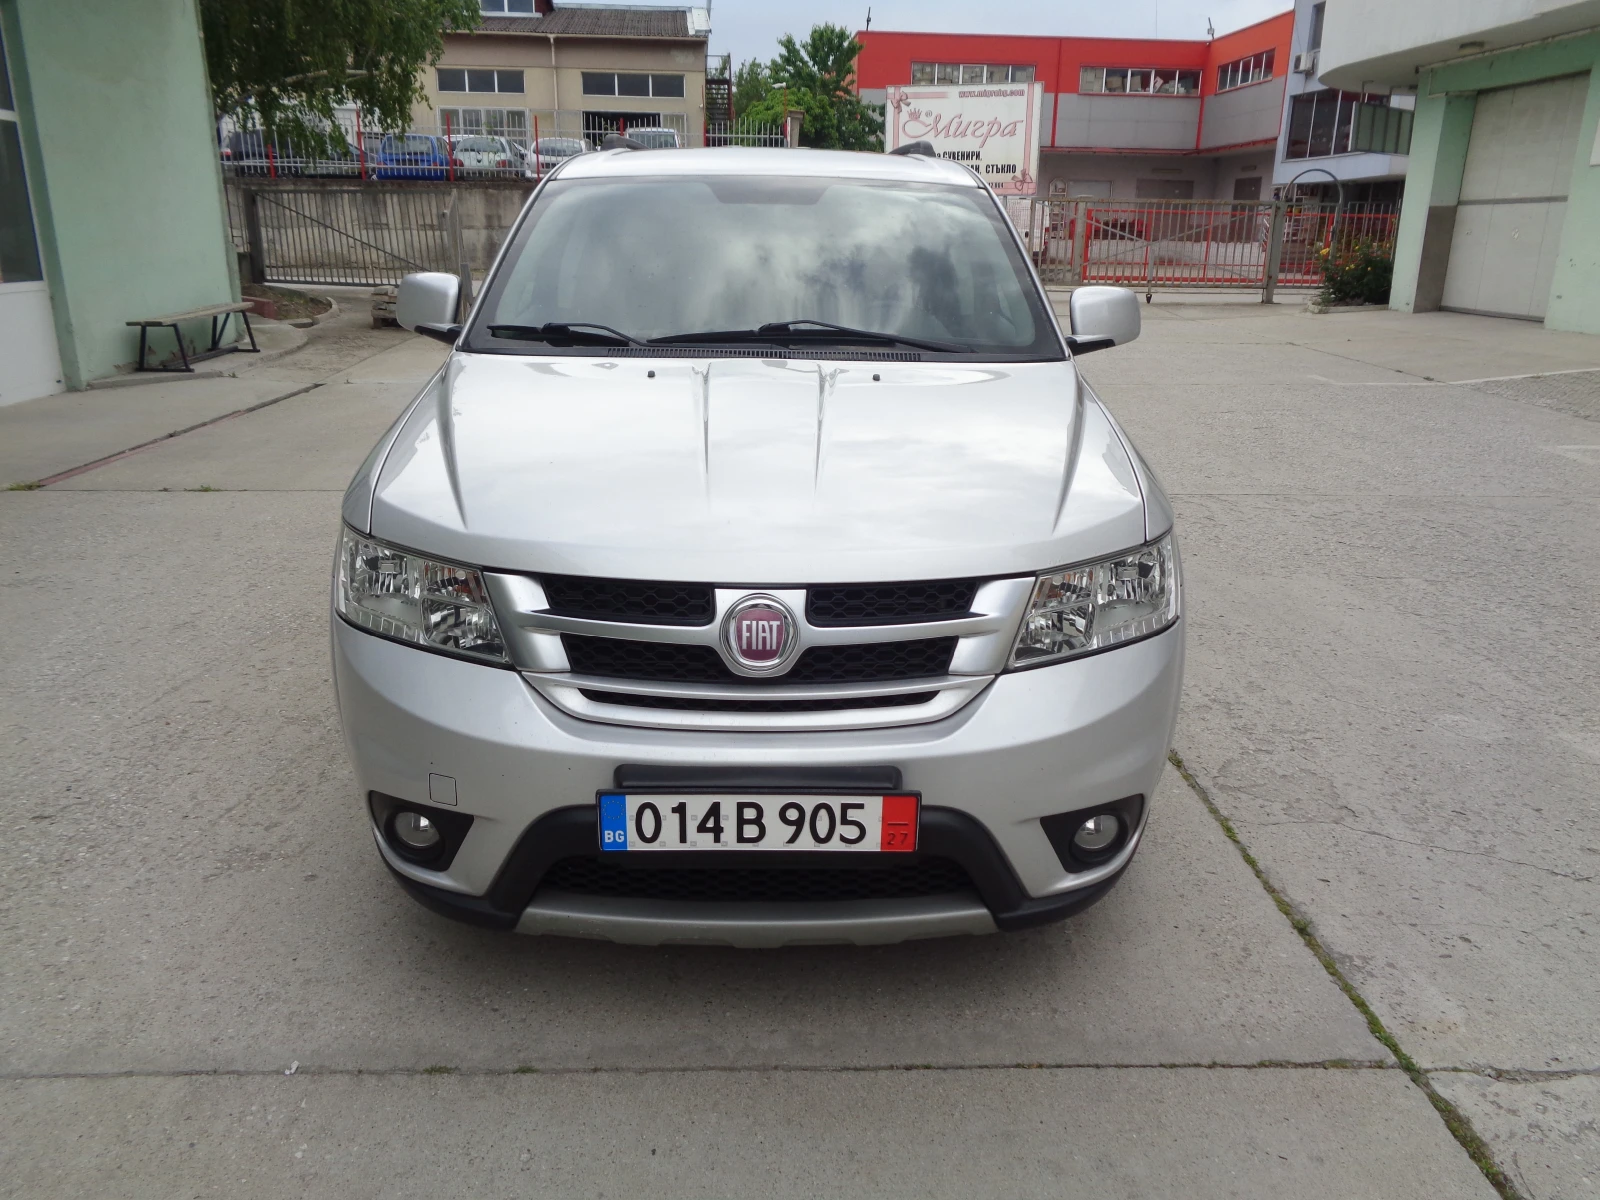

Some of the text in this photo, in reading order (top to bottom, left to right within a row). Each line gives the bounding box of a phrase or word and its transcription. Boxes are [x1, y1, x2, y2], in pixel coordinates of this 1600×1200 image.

[902, 113, 1024, 149] Мигра
[985, 164, 1017, 174] СТЪКЛО
[741, 620, 781, 650] FIAT
[604, 830, 625, 843] BG
